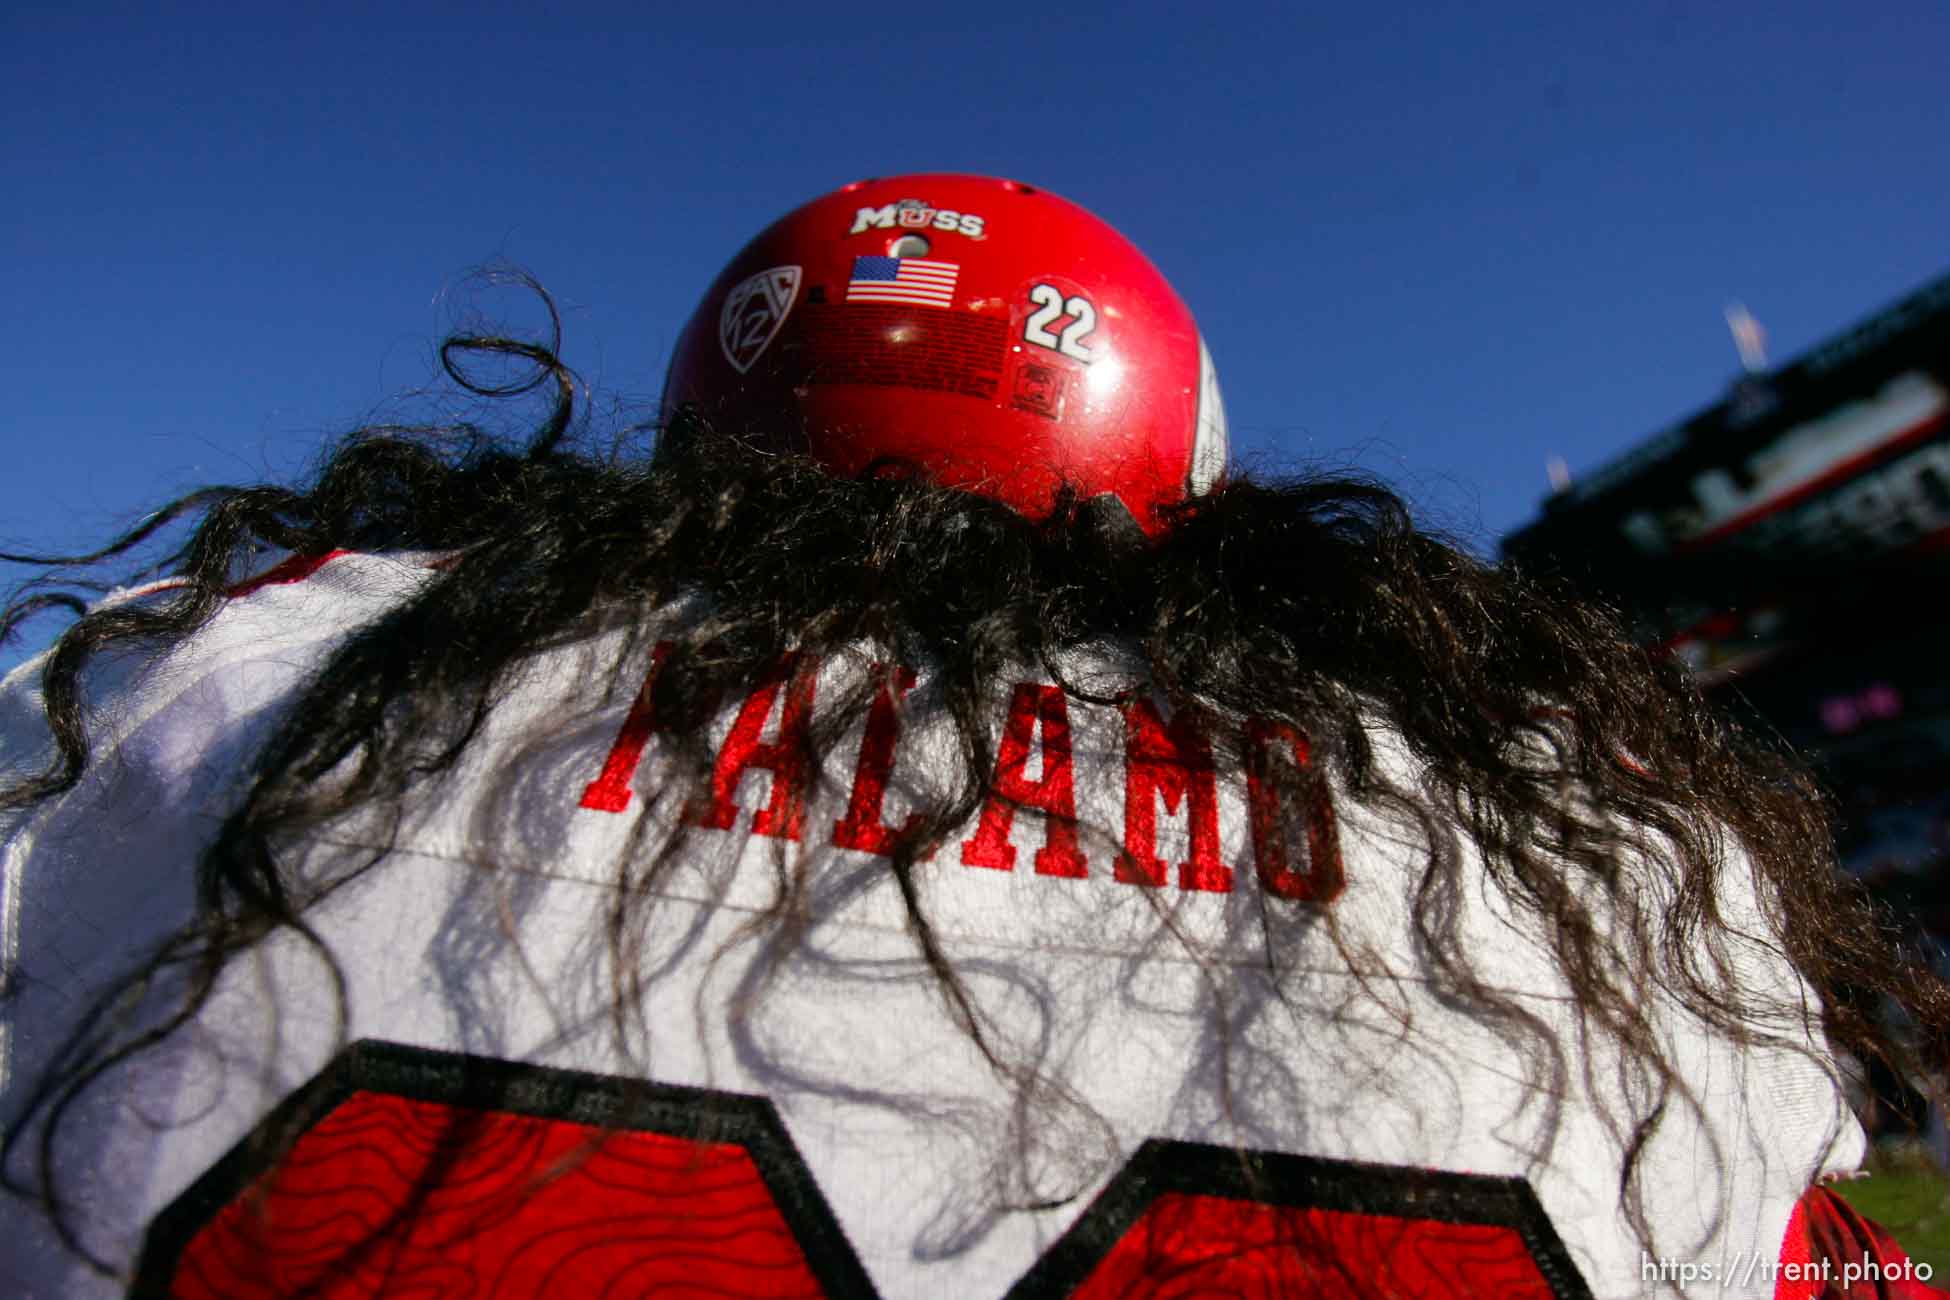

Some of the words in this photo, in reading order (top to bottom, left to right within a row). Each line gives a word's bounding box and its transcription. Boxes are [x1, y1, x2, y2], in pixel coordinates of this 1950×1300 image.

[849, 201, 986, 237] MUSS
[725, 269, 796, 334] PAC
[1023, 283, 1098, 366] 22
